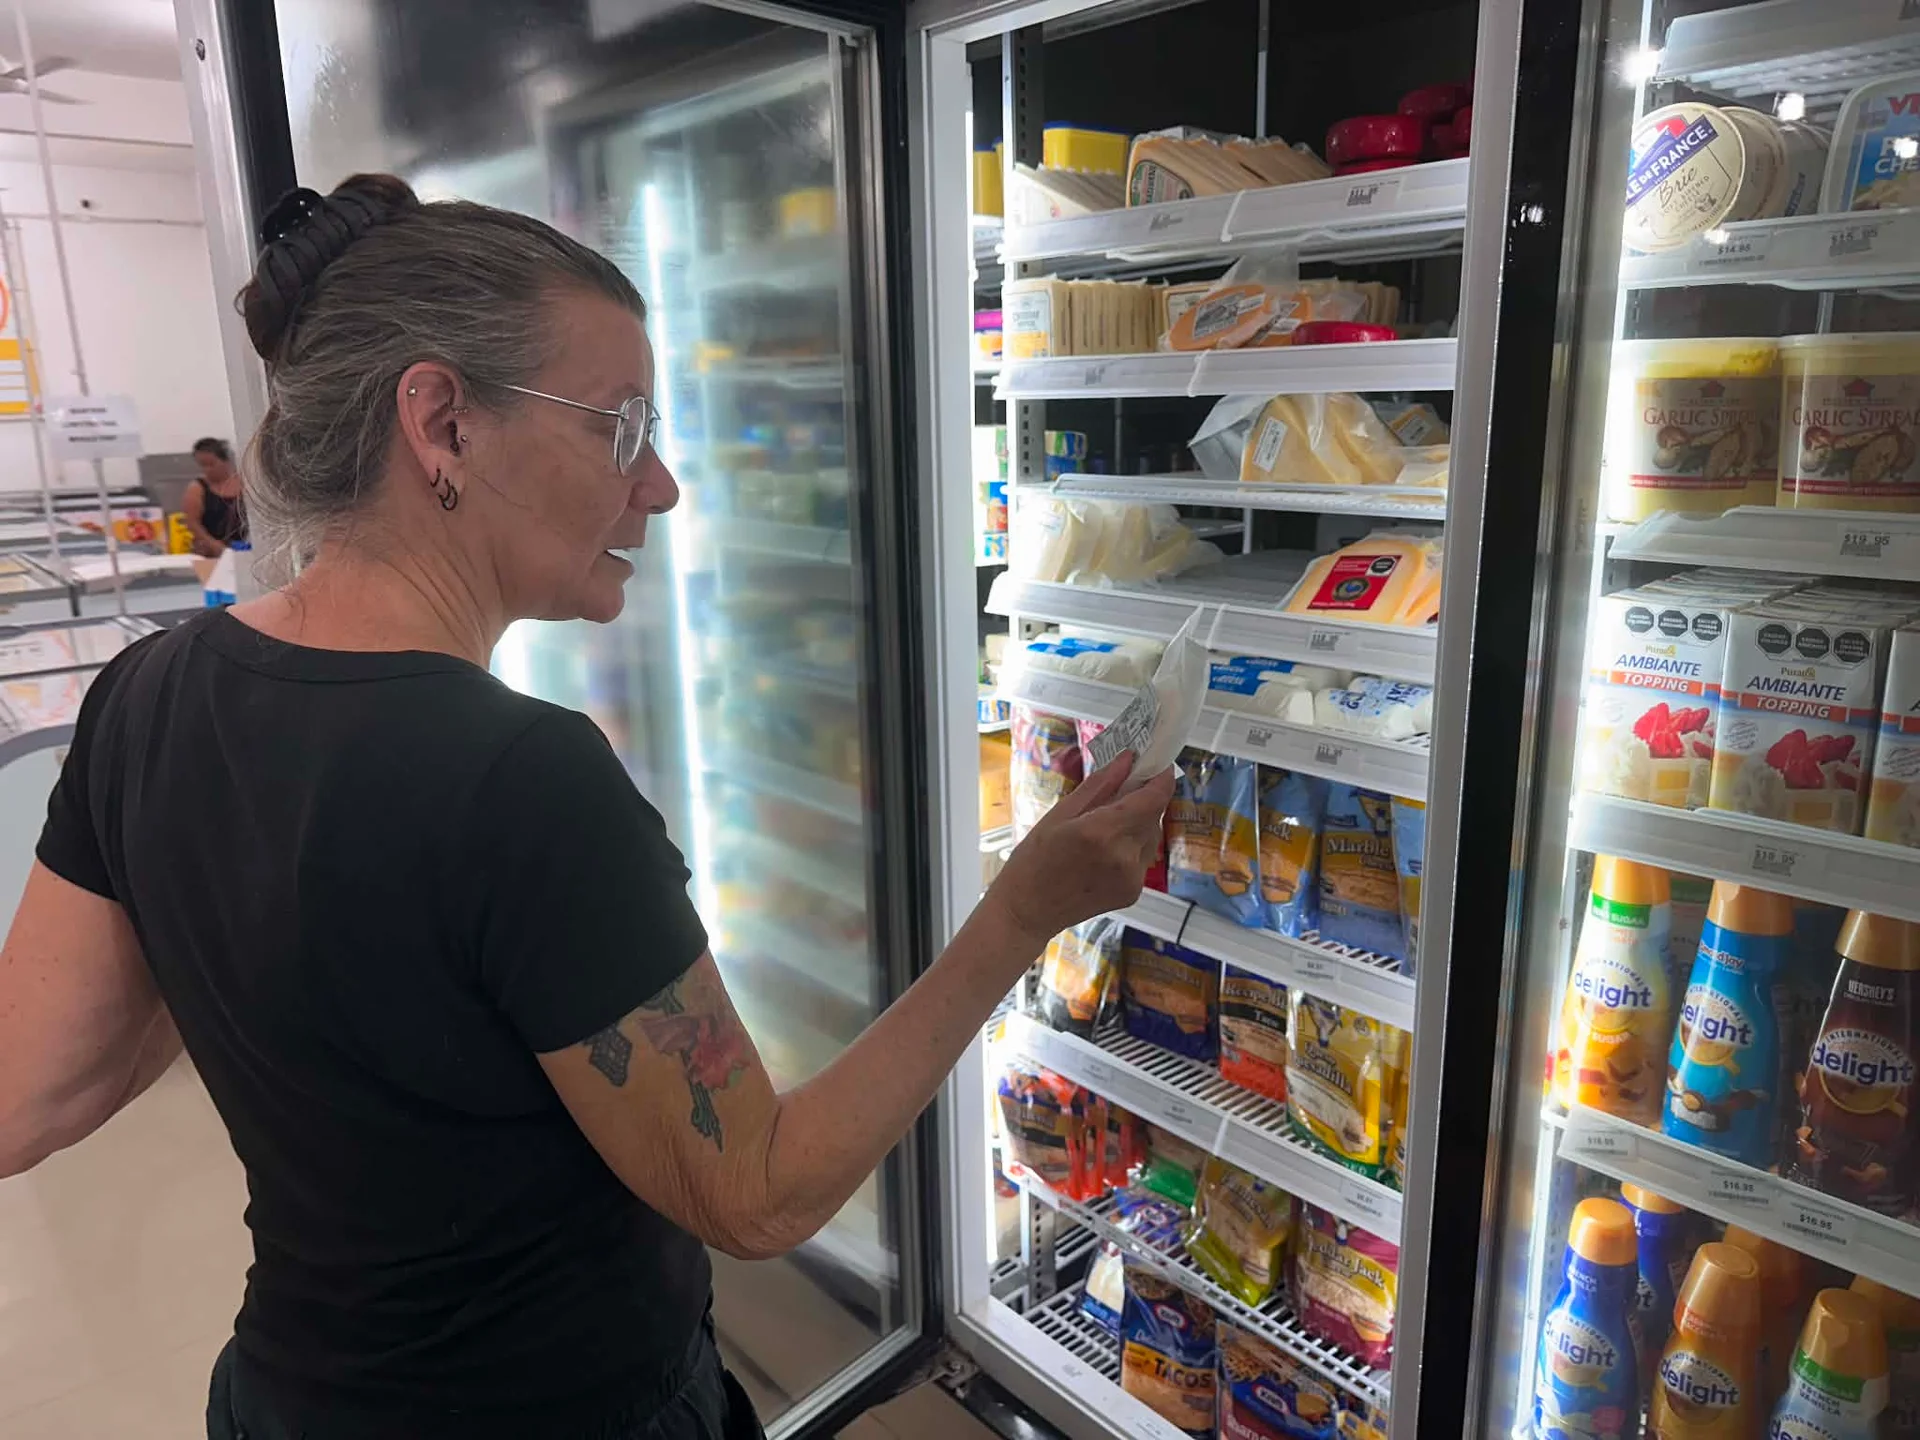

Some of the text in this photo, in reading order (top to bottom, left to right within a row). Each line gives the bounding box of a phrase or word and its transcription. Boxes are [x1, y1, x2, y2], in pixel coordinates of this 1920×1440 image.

[1649, 125, 1708, 177] FRANCE
[1643, 406, 1707, 426] GARLIC
[1615, 654, 1702, 677] AMBIANTE
[1623, 673, 1689, 693] TOPPING
[1746, 675, 1848, 701] AMBIANTE
[1757, 697, 1831, 719] TOPPING
[1574, 970, 1652, 1008] delight
[1812, 1042, 1913, 1085] delight
[1799, 1214, 1833, 1231] $16.95
[1154, 1357, 1214, 1389] TACOS
[1660, 1358, 1740, 1406] delight
